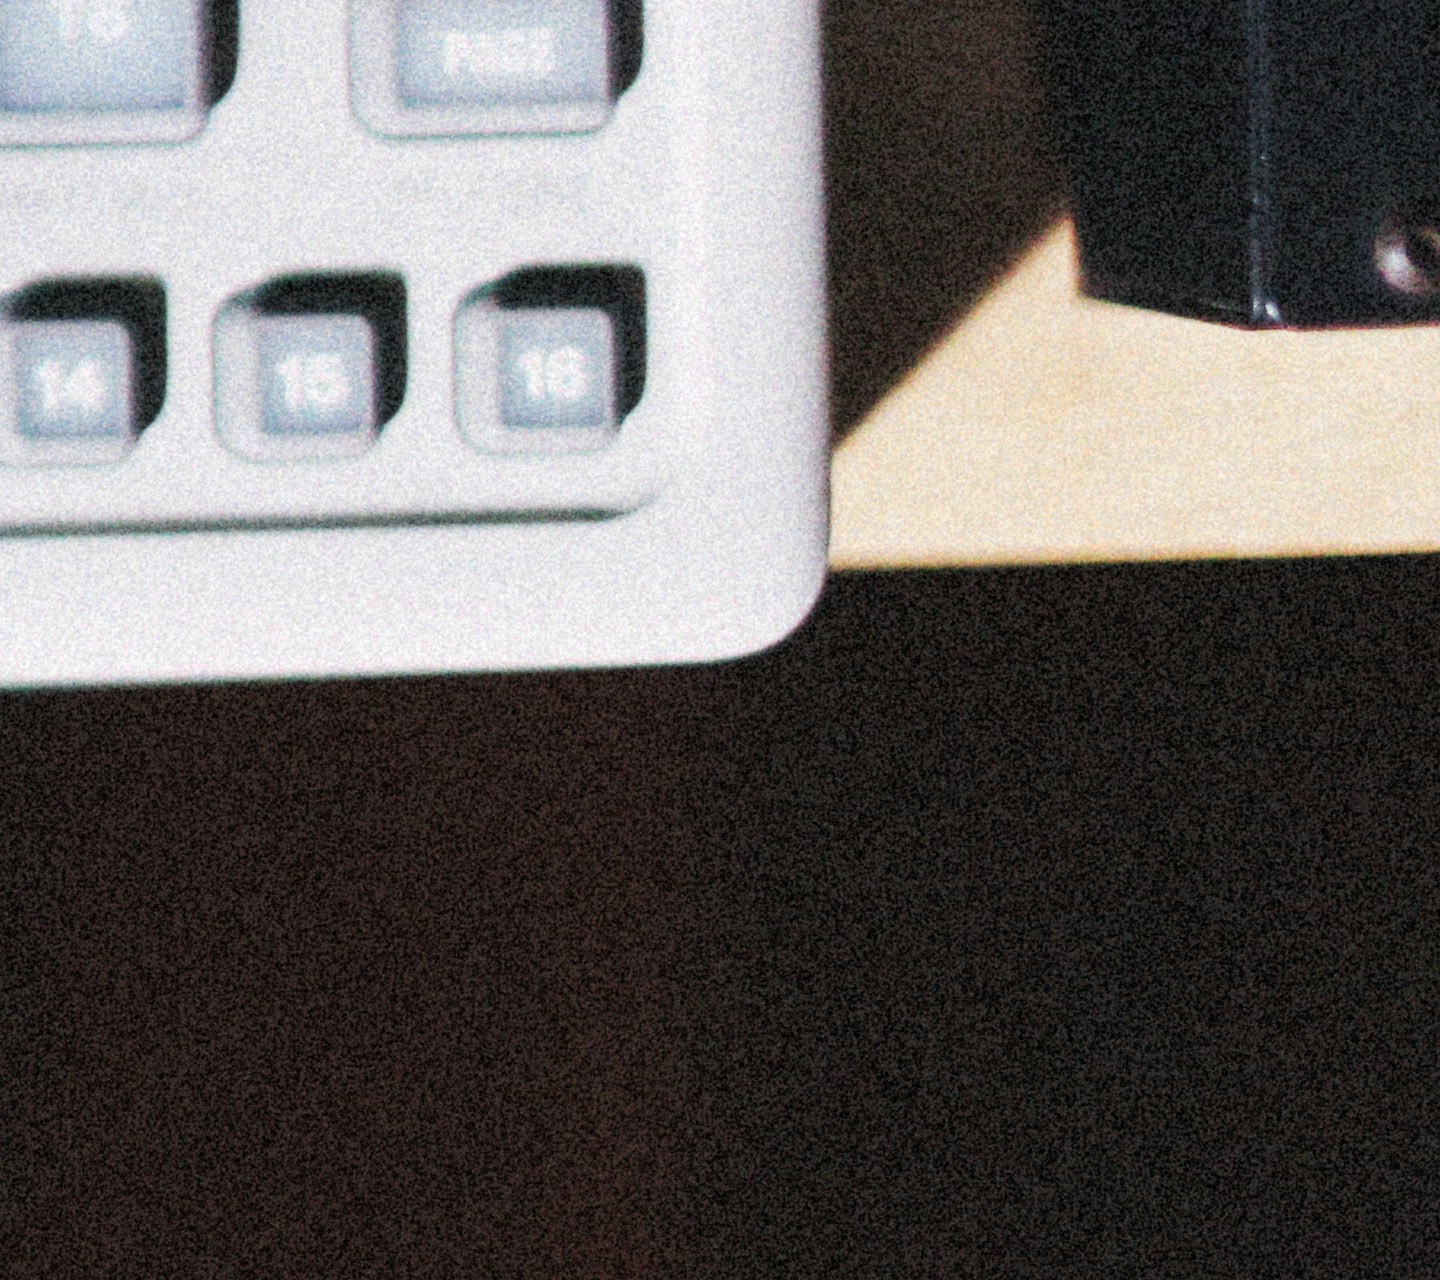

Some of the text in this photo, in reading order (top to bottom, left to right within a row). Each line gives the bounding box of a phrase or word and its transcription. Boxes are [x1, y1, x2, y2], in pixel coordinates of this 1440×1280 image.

[35, 358, 106, 412] 14
[276, 353, 350, 410] 15
[518, 345, 589, 401] 16
